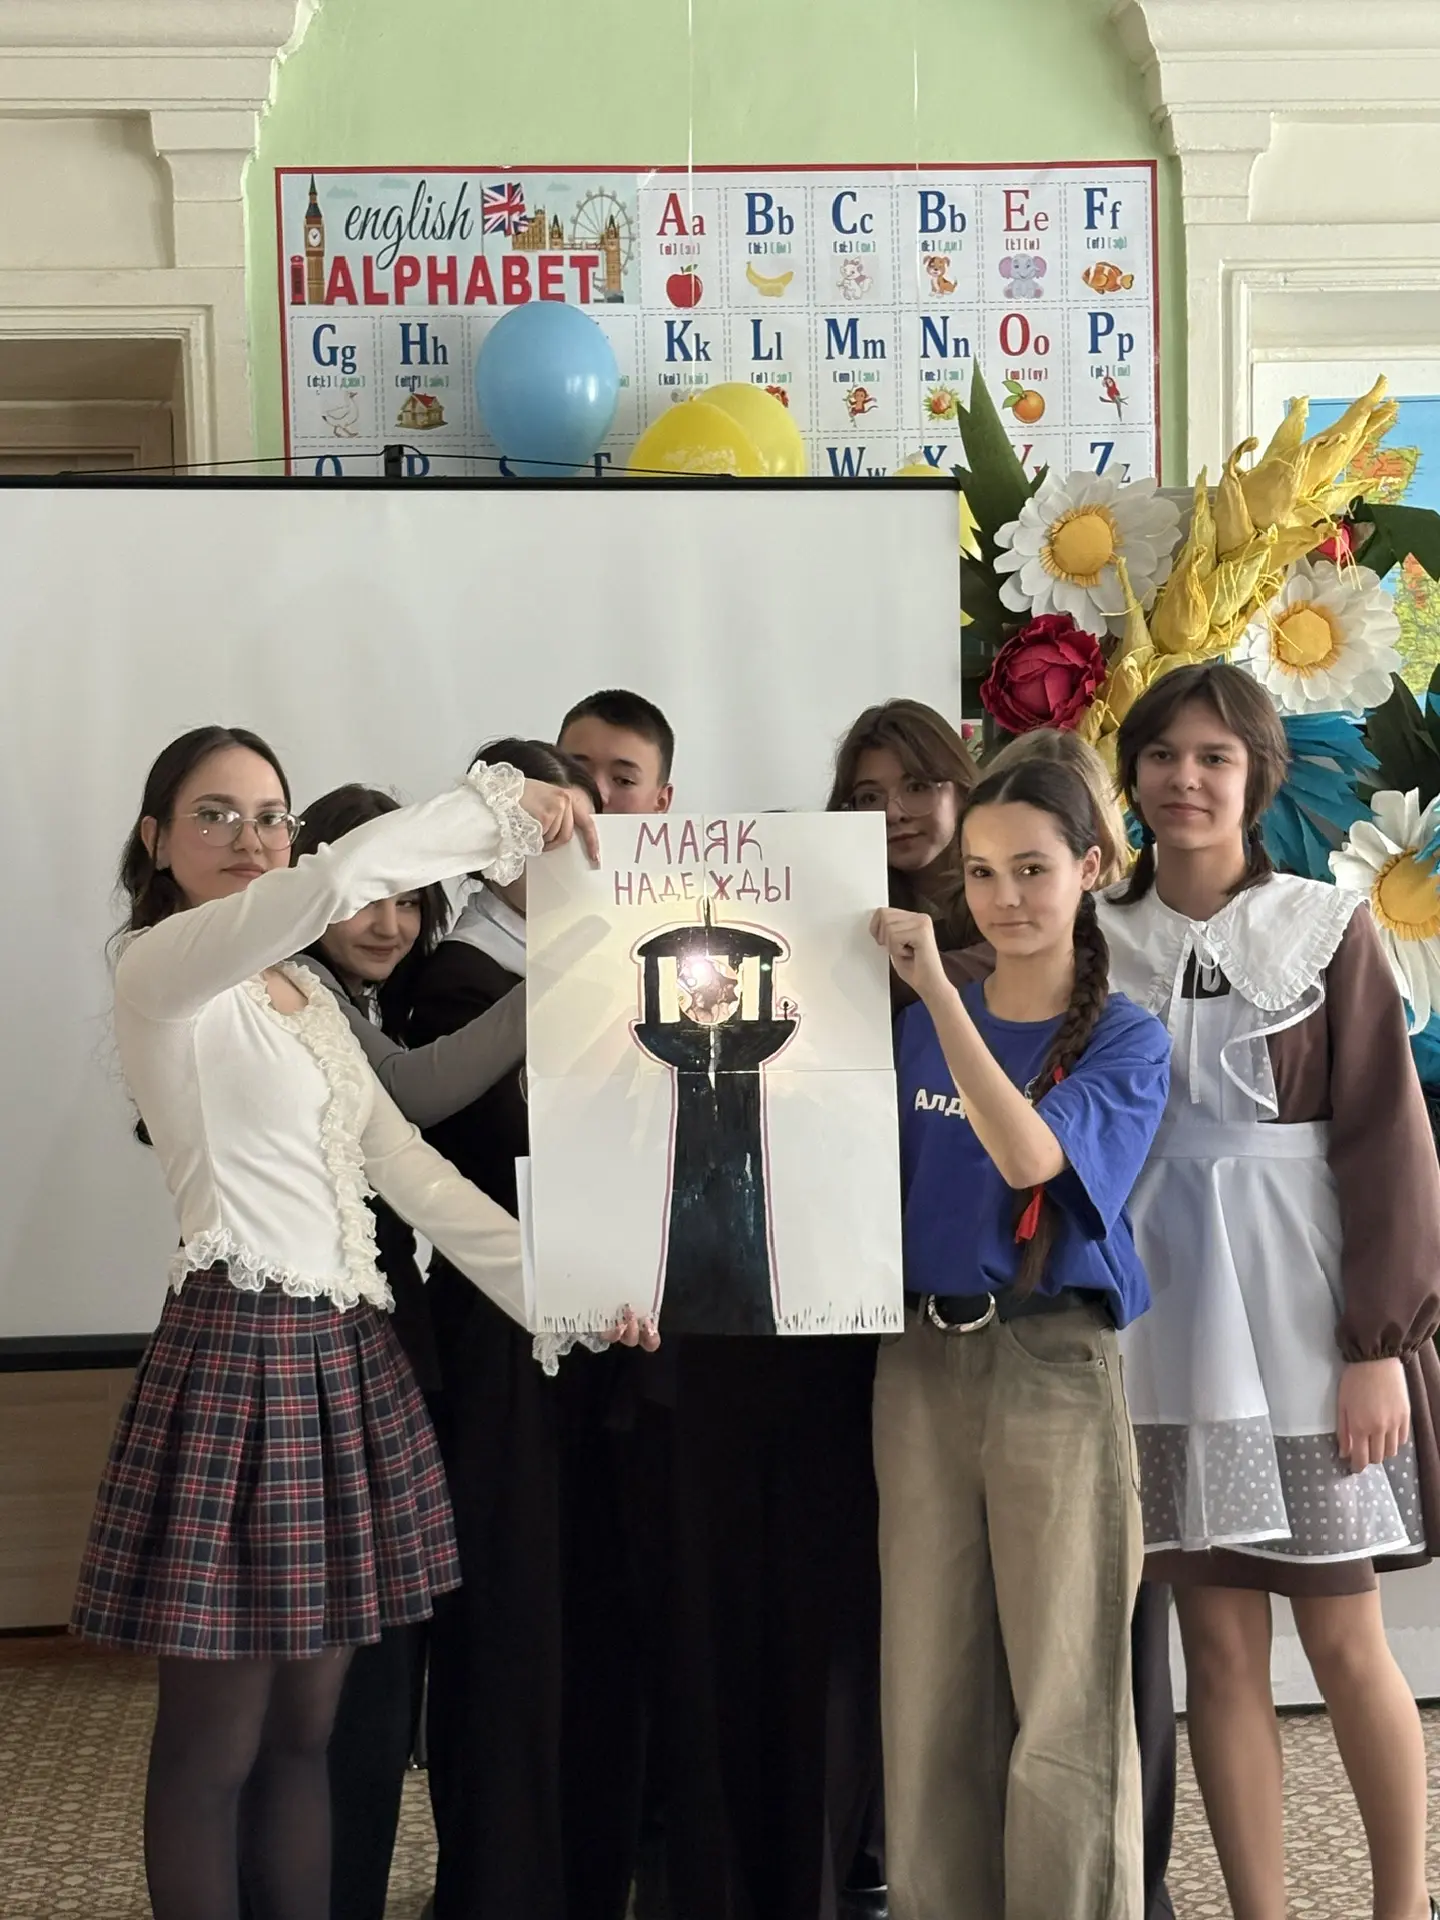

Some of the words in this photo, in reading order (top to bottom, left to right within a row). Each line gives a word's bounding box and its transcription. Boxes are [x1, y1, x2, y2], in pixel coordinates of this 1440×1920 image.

[345, 180, 473, 270] english
[656, 192, 706, 236] Aa
[744, 192, 794, 235] Bb
[831, 190, 873, 234] Cc
[917, 190, 967, 233] Bb
[1002, 189, 1049, 232] Ee
[1083, 187, 1122, 230] Ff
[323, 255, 600, 306] ALPHABET
[312, 323, 357, 375] Gg
[399, 322, 449, 365] Hh
[664, 320, 712, 362] Kk
[750, 318, 783, 361] Ll
[825, 318, 887, 359] Mm
[920, 315, 971, 358] Nn
[999, 312, 1050, 356] Oo
[1087, 311, 1134, 361] Pp
[634, 819, 763, 865] МАЯК
[614, 866, 790, 905] НАДЕЖДЫ
[914, 1088, 967, 1119] Алд
